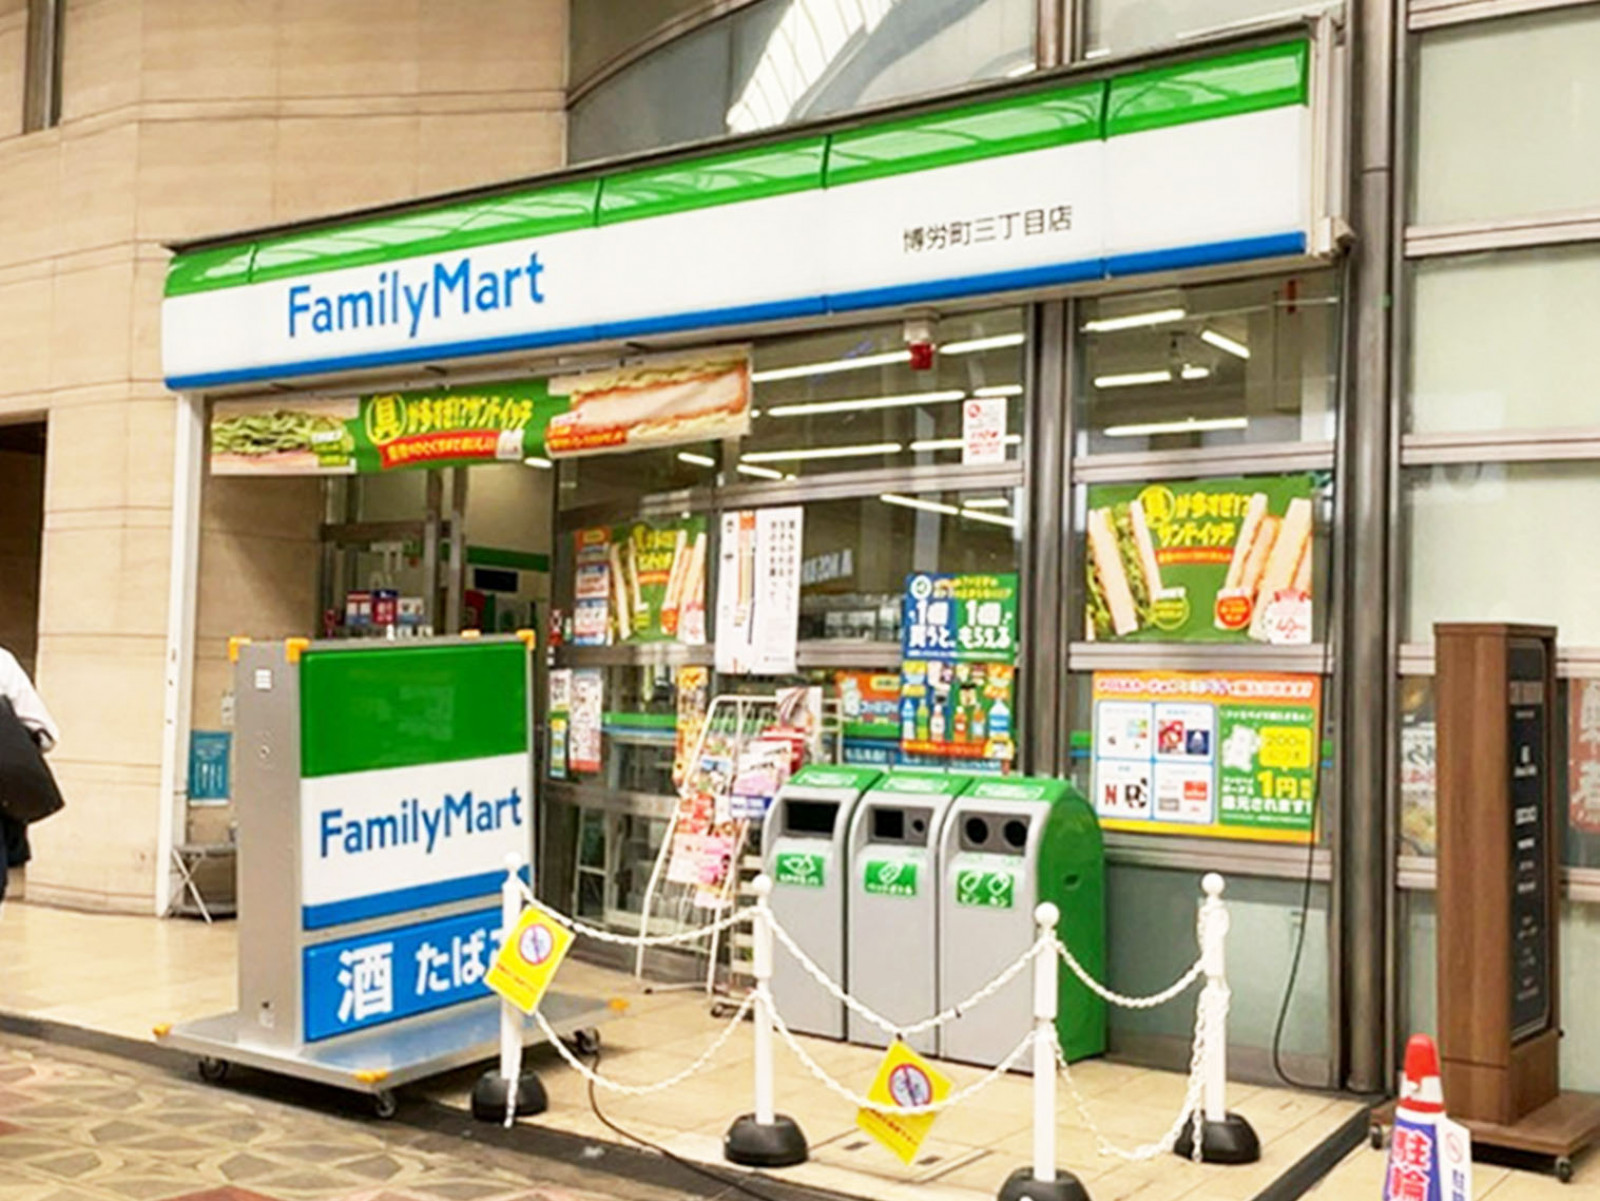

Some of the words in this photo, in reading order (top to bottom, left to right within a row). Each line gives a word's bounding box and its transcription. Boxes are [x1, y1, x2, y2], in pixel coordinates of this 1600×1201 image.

[903, 205, 1072, 253] 博労町三丁目店
[289, 252, 544, 338] FamilyMart
[320, 787, 523, 858] FamilyMart
[337, 941, 394, 1023] 酒
